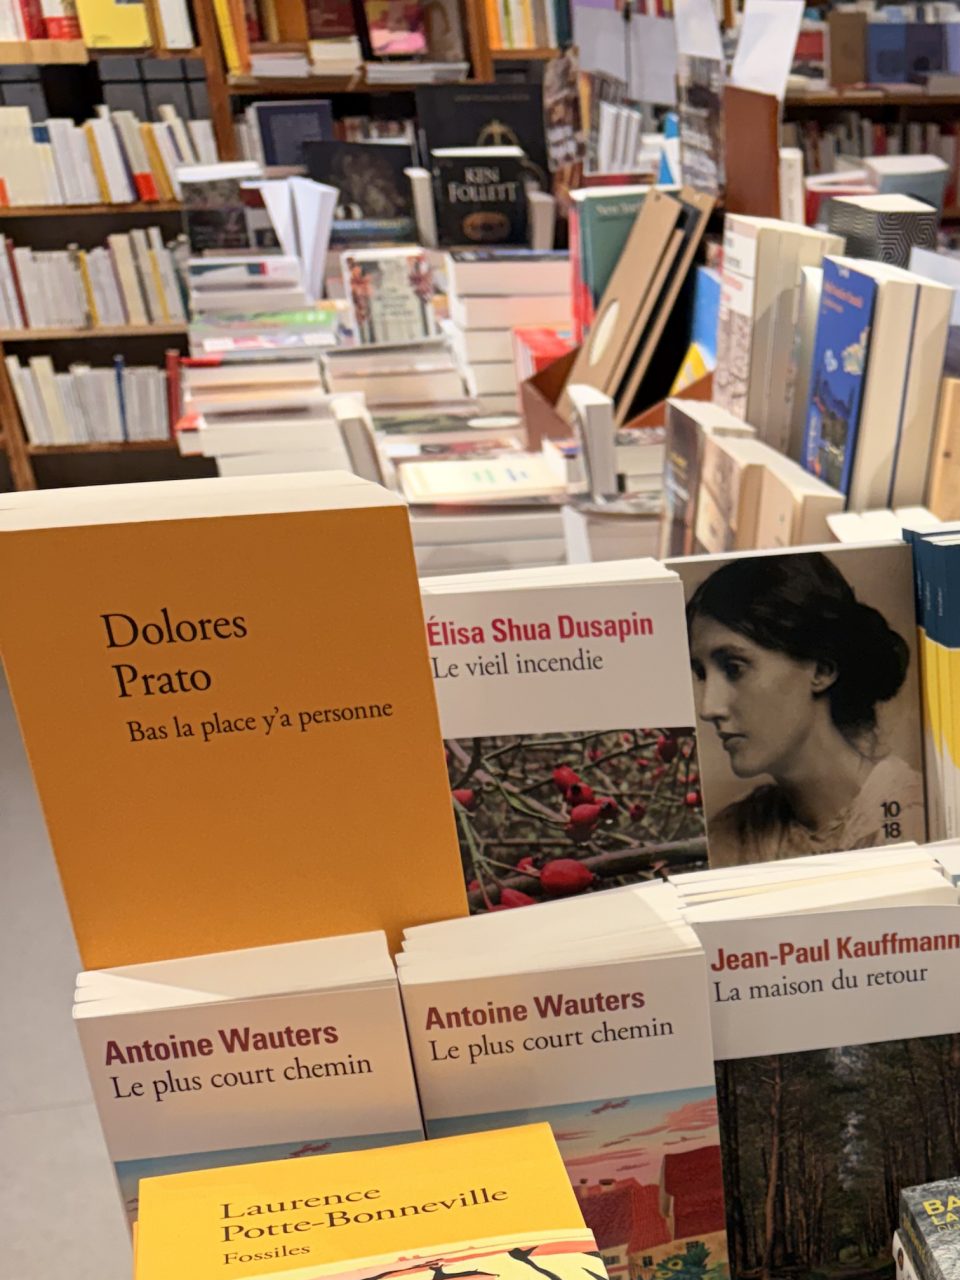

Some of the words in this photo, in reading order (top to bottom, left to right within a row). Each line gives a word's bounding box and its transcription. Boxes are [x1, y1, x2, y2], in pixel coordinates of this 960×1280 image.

[101, 607, 247, 648] Dolores
[426, 614, 485, 647] Élisa
[492, 616, 551, 643] Shua
[558, 611, 653, 643] Dusapin
[112, 663, 212, 698] Prato
[431, 657, 459, 680] Le
[465, 652, 508, 677] vieil
[517, 647, 604, 675] incendie
[126, 720, 168, 742] Bas
[173, 716, 195, 738] la
[200, 711, 256, 742] place
[262, 706, 293, 735] y'a
[299, 702, 394, 732] personne
[881, 800, 900, 817] 10
[882, 822, 901, 839] 18
[710, 939, 831, 973] Jean-Paul
[837, 931, 960, 960] Kauffmann
[713, 980, 741, 1003] La
[747, 972, 824, 1000] maison
[831, 968, 858, 992] du
[866, 963, 929, 988] retour
[105, 1034, 213, 1067] Antoine
[218, 1023, 339, 1058] Wauters
[110, 1075, 145, 1101] Le
[153, 1067, 202, 1102] plus
[210, 1062, 275, 1089] court
[283, 1053, 373, 1083] chemin
[219, 1186, 381, 1219] Laurence
[219, 1186, 509, 1243] Potte-Bonneville
[222, 1243, 311, 1266] Fossiles
